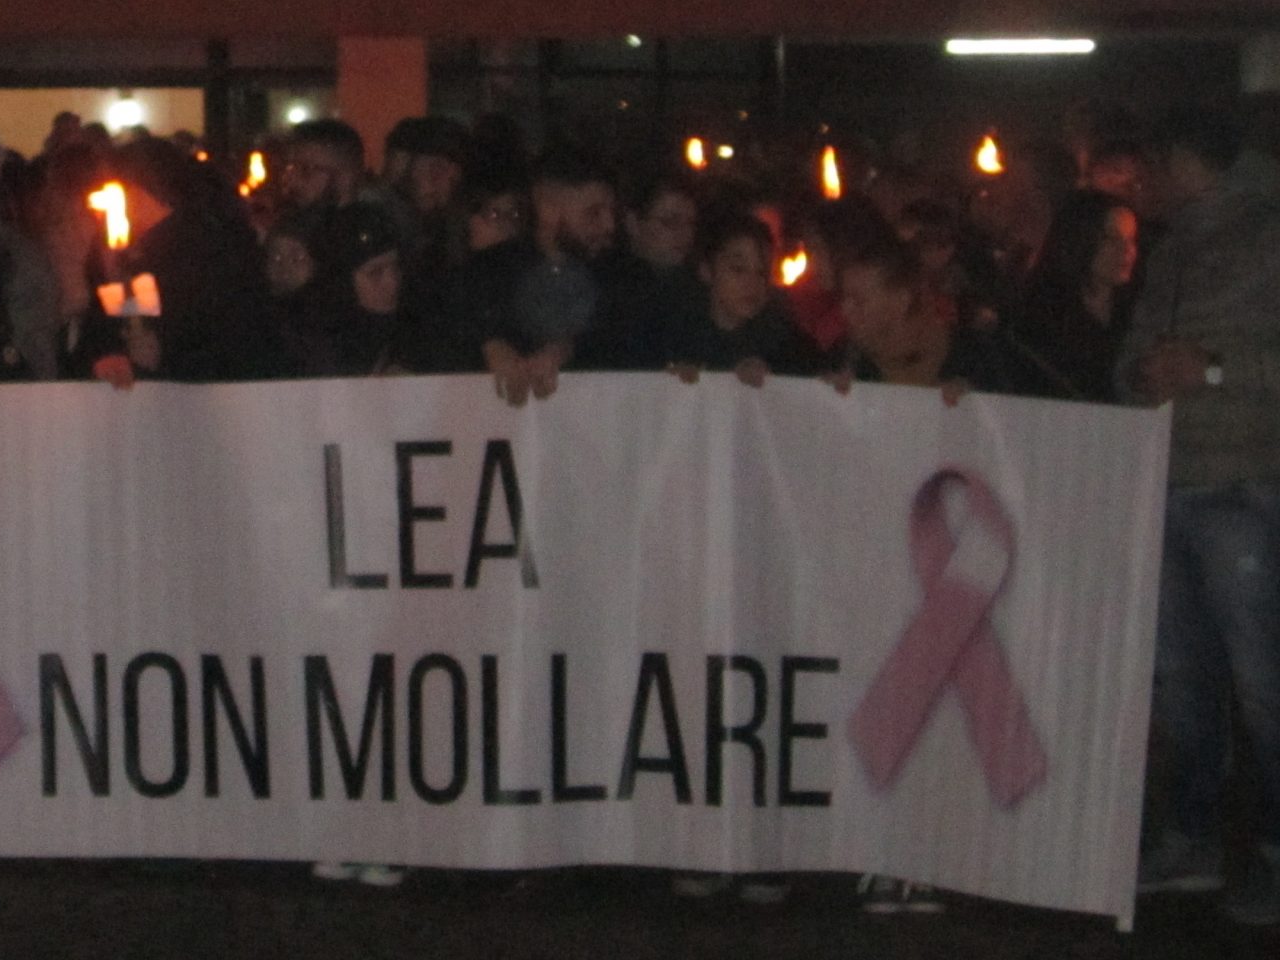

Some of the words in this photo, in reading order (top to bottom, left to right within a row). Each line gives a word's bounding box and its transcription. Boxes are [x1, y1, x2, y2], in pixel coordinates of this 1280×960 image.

[324, 440, 538, 589] LEA
[40, 652, 269, 800] NON
[305, 652, 840, 808] MOLLARE
